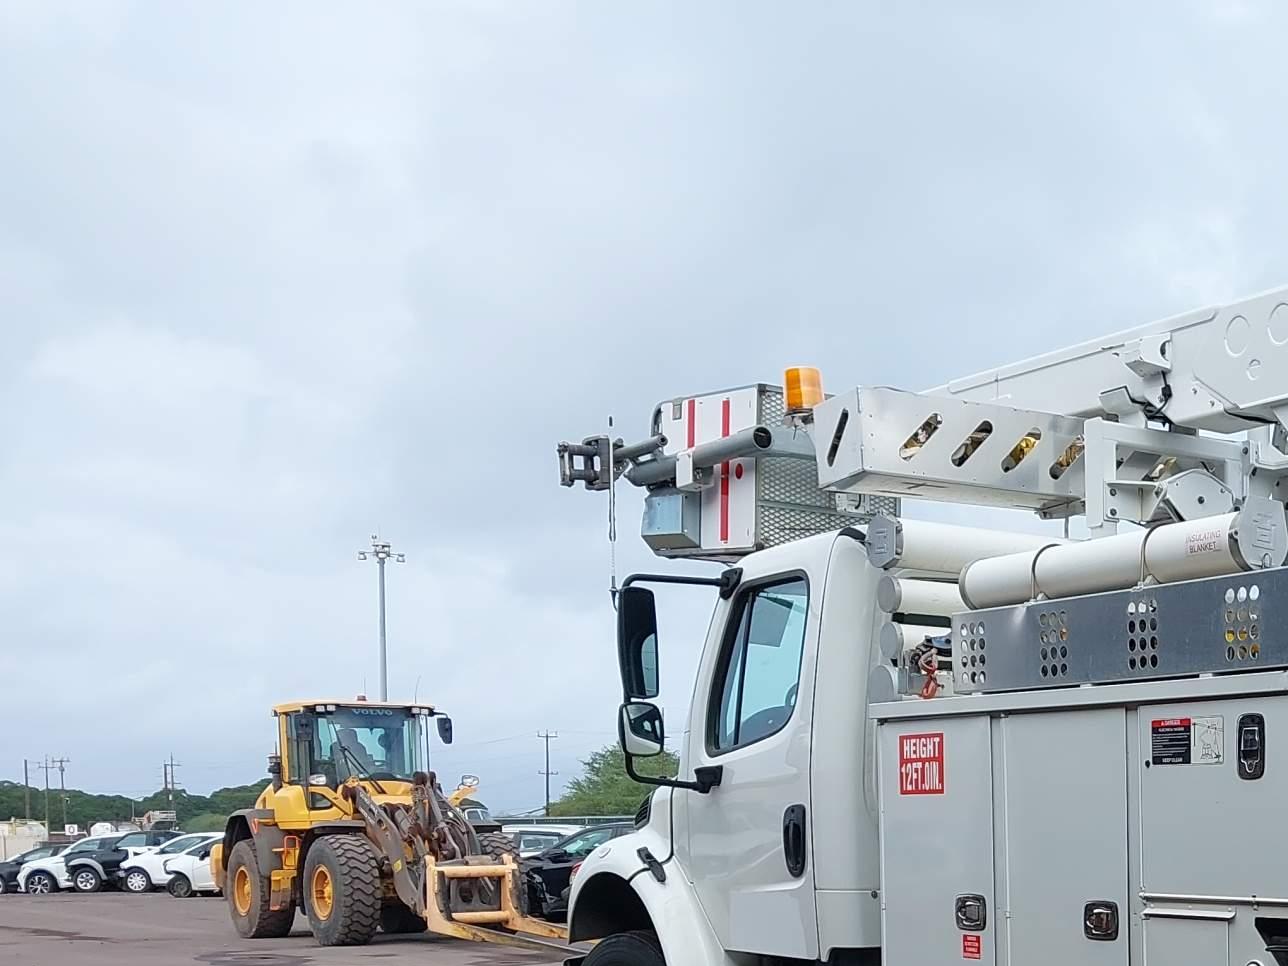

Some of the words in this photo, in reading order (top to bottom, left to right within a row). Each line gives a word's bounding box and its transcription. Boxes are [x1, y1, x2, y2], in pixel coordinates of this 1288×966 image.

[1189, 541, 1216, 553] BLANKET
[352, 708, 393, 716] VOLVO
[903, 737, 940, 760] HEIGHT
